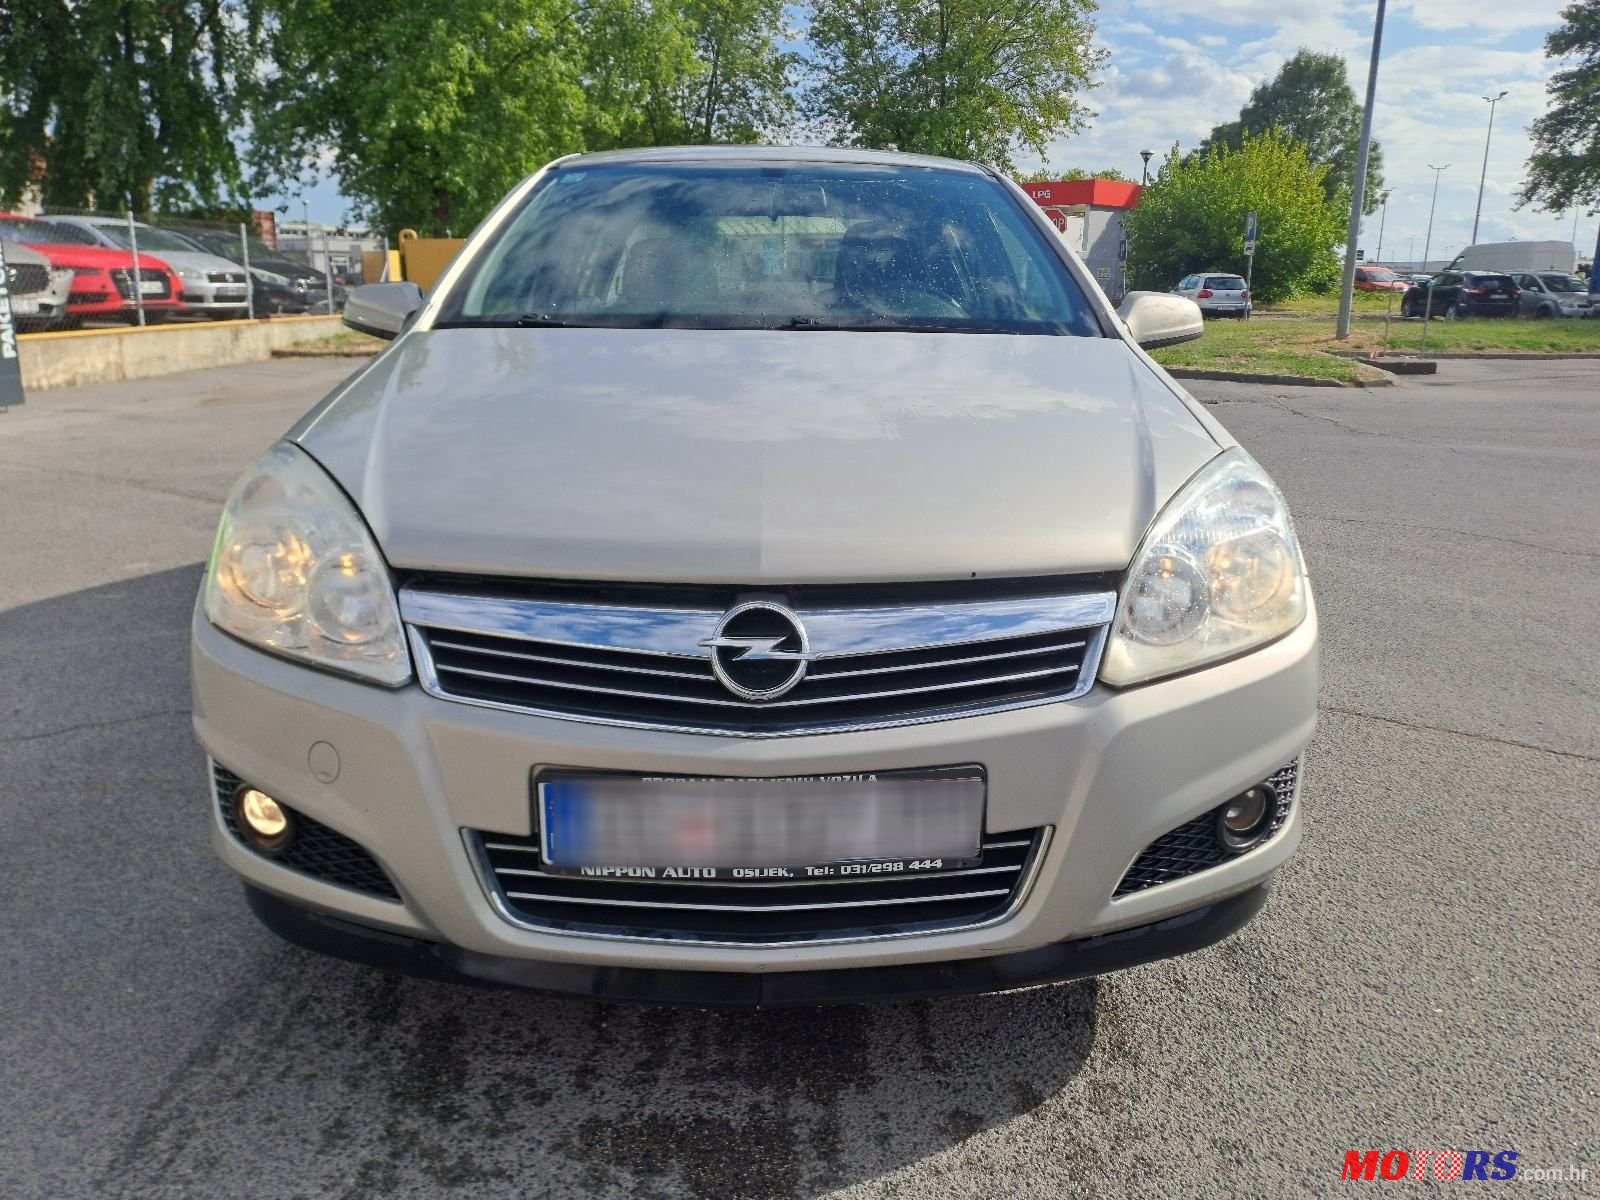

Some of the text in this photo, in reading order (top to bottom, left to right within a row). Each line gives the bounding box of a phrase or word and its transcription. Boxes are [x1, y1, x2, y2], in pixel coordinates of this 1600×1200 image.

[1032, 189, 1051, 199] LPG
[1052, 218, 1064, 230] OP
[0, 246, 17, 359] PAKETO
[581, 858, 943, 878] NIPPON AUTO OSIJEK, Tel: 031/298 444
